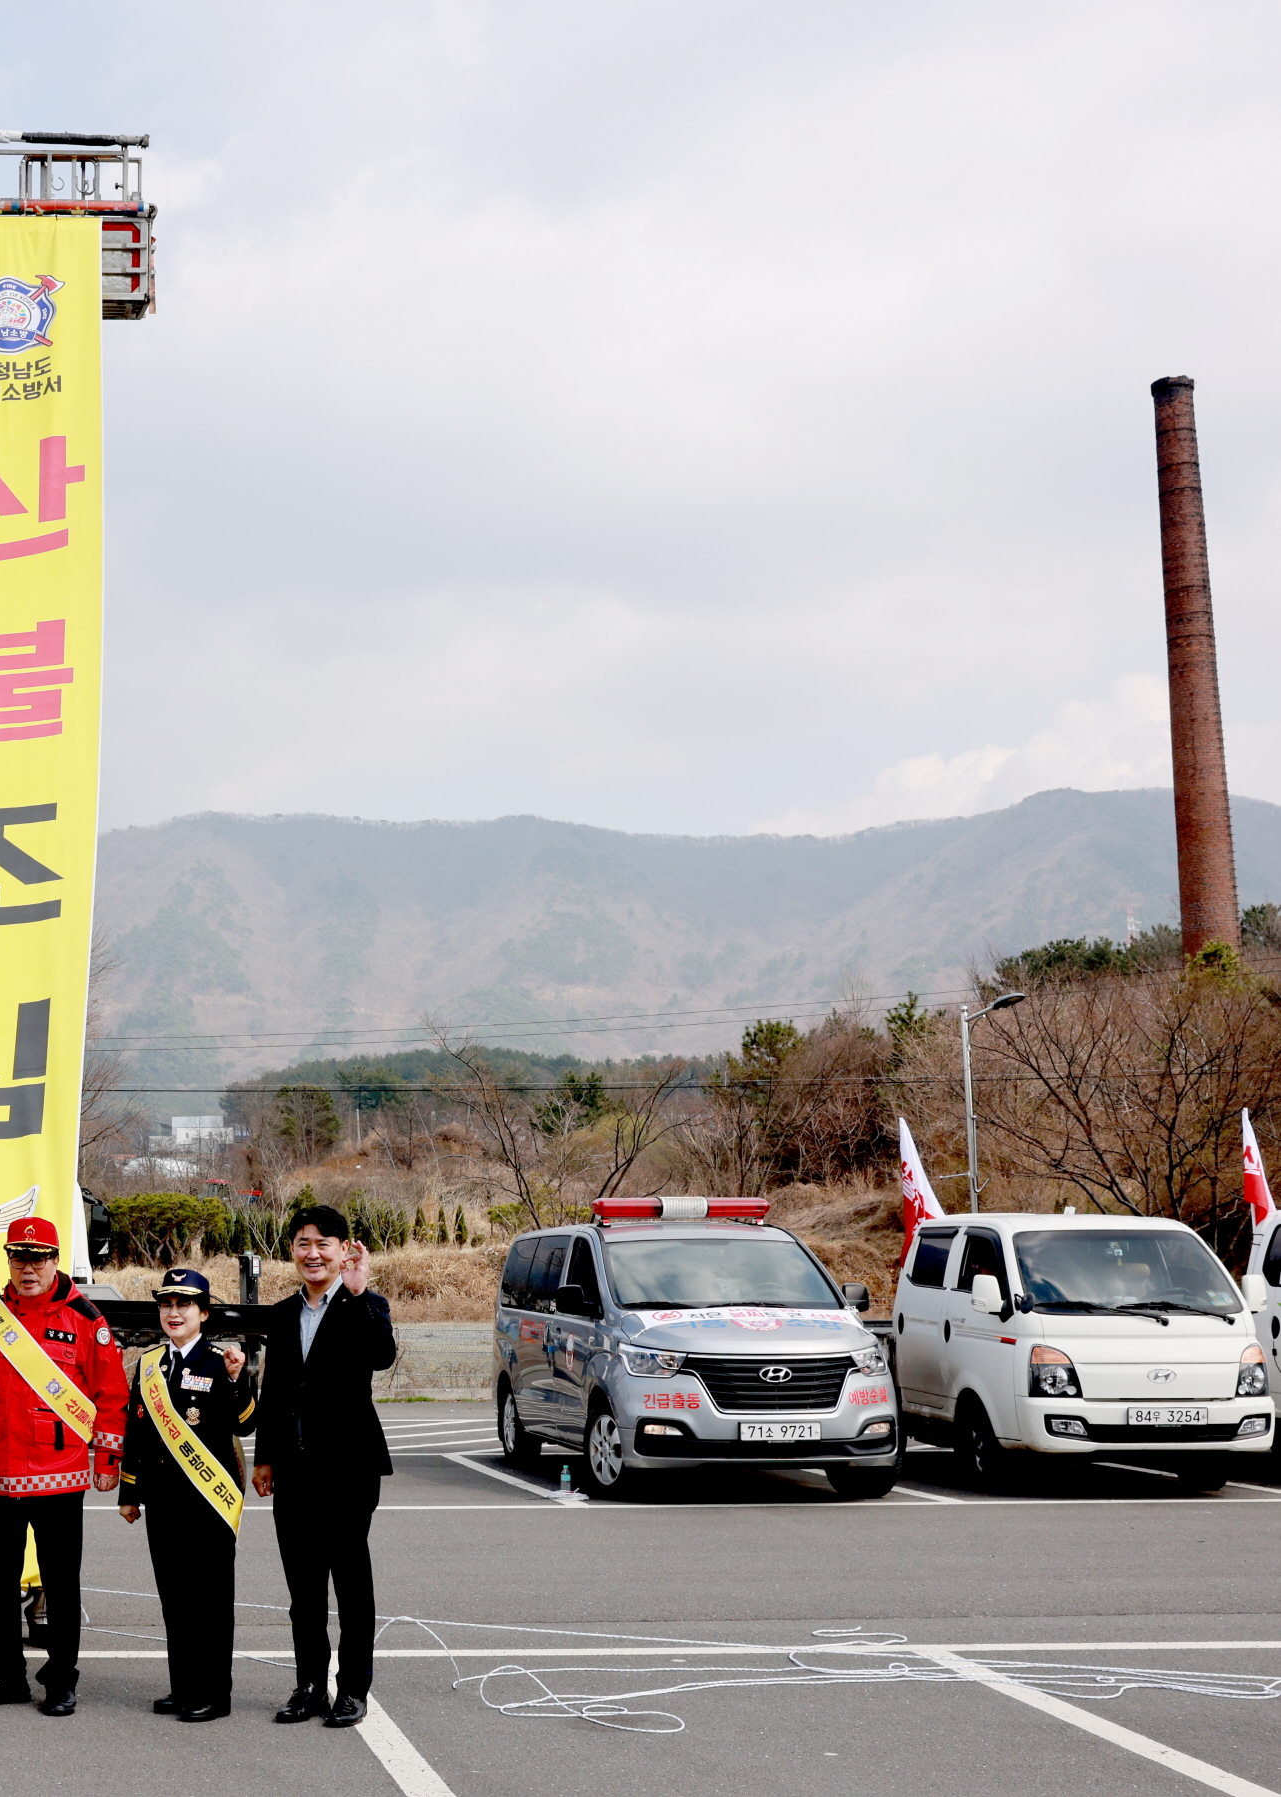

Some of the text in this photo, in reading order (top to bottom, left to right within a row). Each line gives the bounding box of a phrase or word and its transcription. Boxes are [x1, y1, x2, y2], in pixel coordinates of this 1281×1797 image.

[19, 293, 36, 310] KOREA
[687, 1311, 724, 1319] 작은
[729, 1310, 783, 1318] 불씨도
[643, 1392, 701, 1409] 긴급출동
[848, 1386, 888, 1406] 예방순찰
[1135, 1410, 1201, 1423] 84우 3254
[747, 1425, 813, 1439] 71소 9721
[148, 1383, 236, 1510] 산불조심 예방이 먼저
